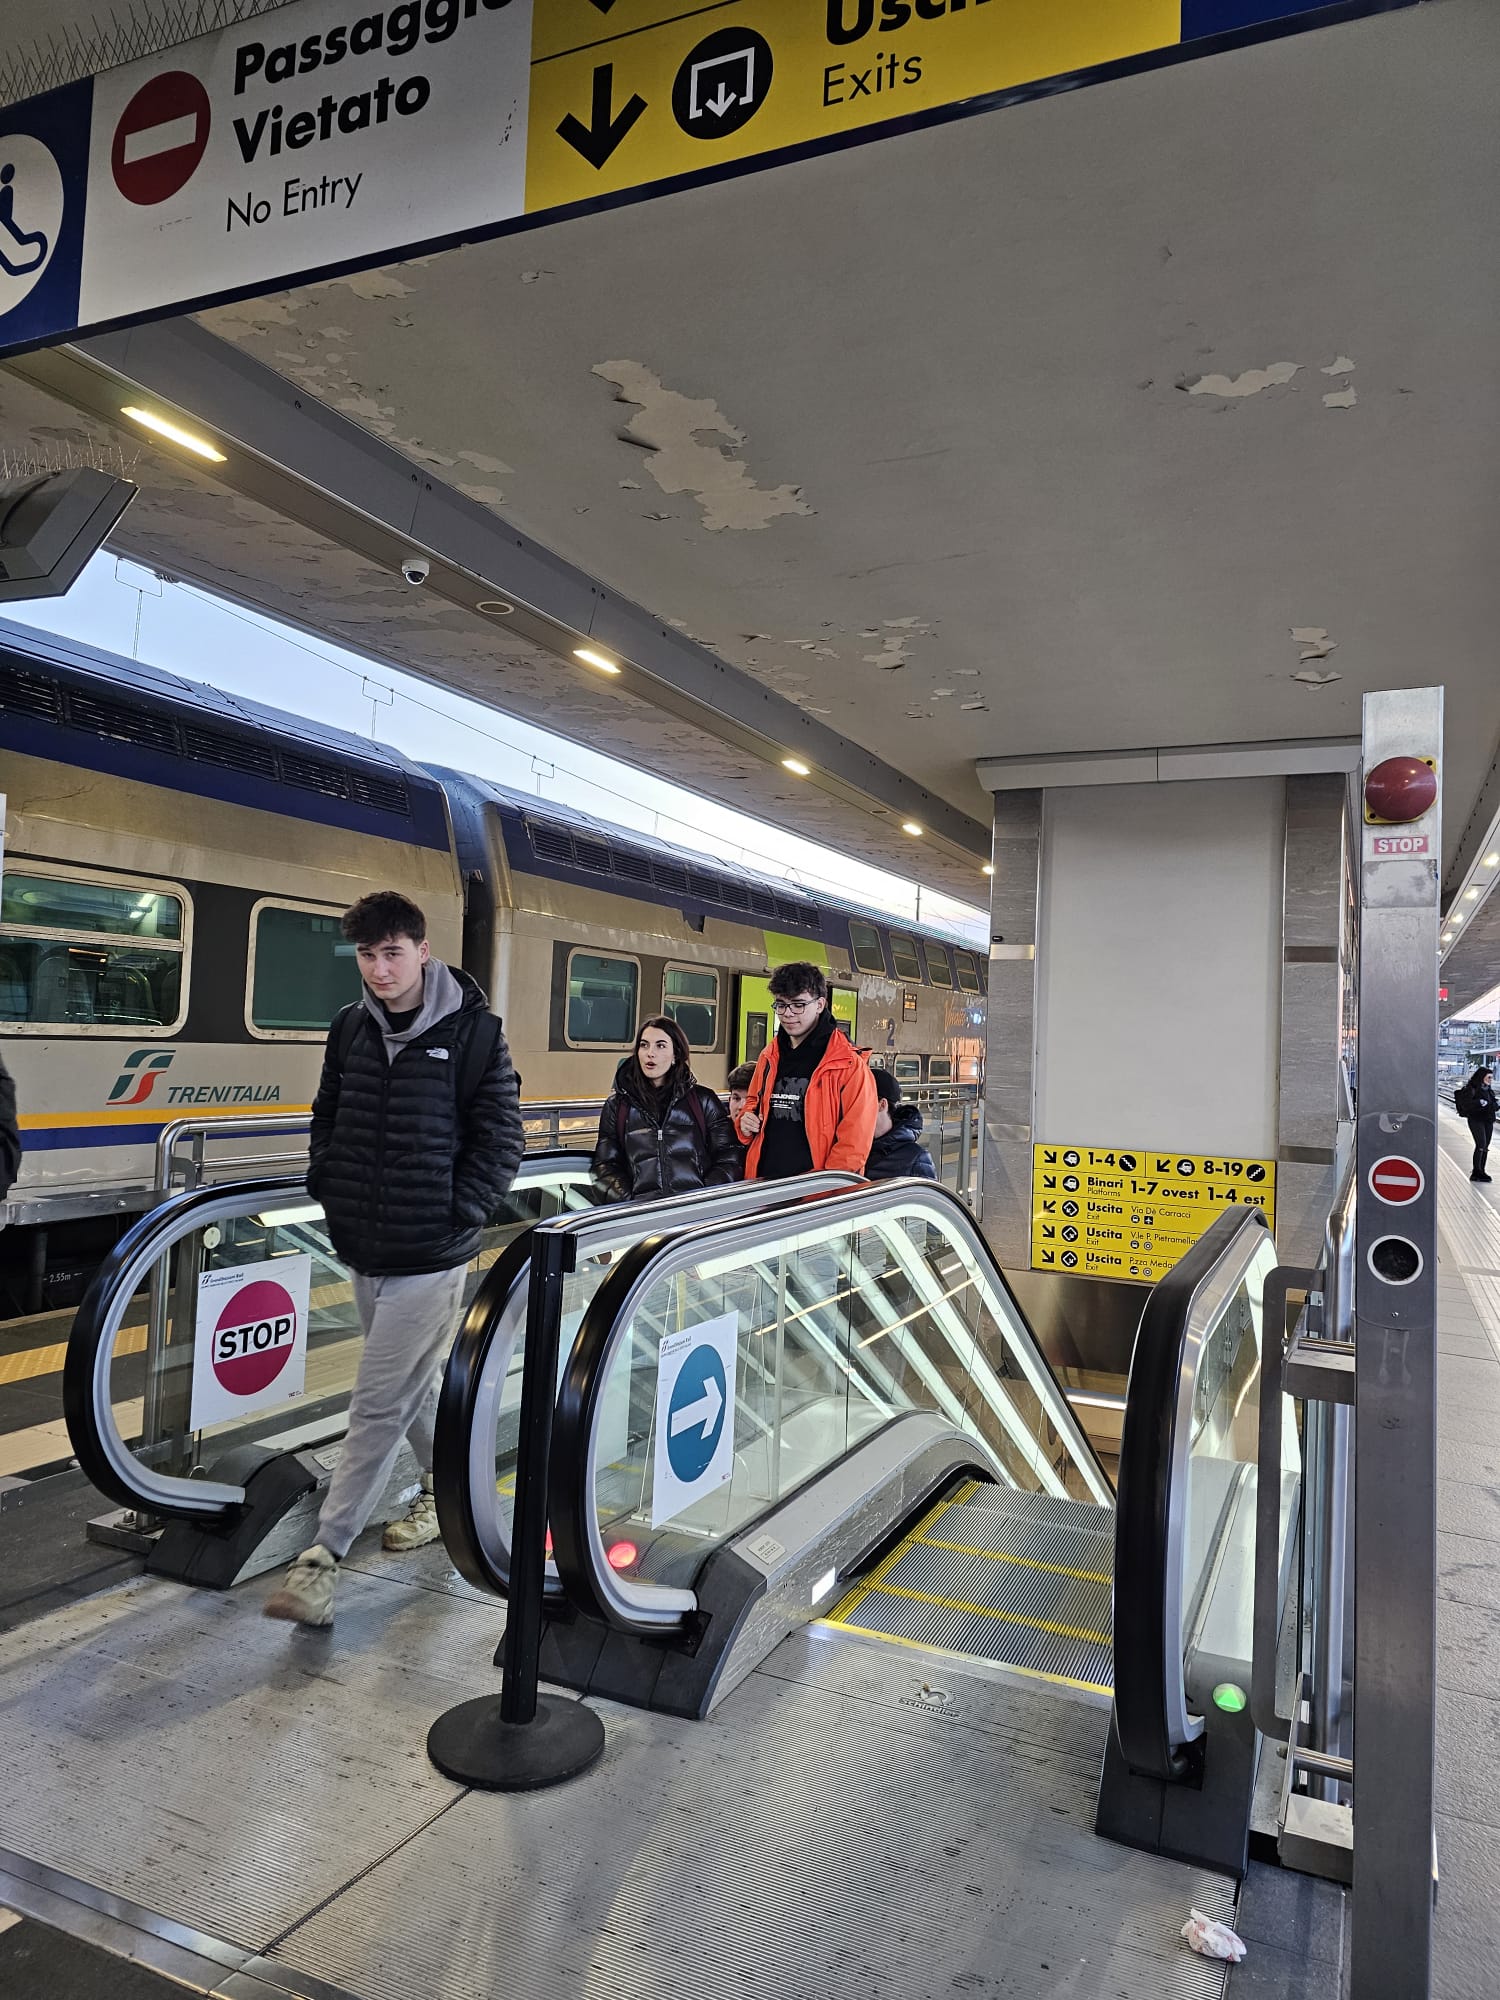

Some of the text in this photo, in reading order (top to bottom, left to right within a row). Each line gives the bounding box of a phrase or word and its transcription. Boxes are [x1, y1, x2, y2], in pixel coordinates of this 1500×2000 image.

[823, 52, 923, 107] Exits
[233, 72, 432, 163] Vietato
[226, 172, 363, 232] No Entry
[1378, 838, 1424, 853] STOP
[167, 1085, 281, 1104] TRENITALIA
[1088, 1152, 1115, 1166] 1-4
[1203, 1160, 1243, 1176] 8-19
[1087, 1187, 1121, 1197] Platforms
[1088, 1176, 1265, 1205] Binari 1-7 ovest 1-4 est
[1086, 1212, 1100, 1220] Exit
[1087, 1202, 1123, 1214] Uscita
[1131, 1206, 1143, 1214] Via
[1159, 1208, 1191, 1219] Carracci
[1086, 1227, 1122, 1239] Uscita
[1086, 1237, 1099, 1246] Exit
[1085, 1262, 1098, 1271] Exit
[1086, 1252, 1175, 1269] Uscita P.zza Meda
[49, 1272, 71, 1283] 2.55m
[218, 1317, 291, 1360] STOP
